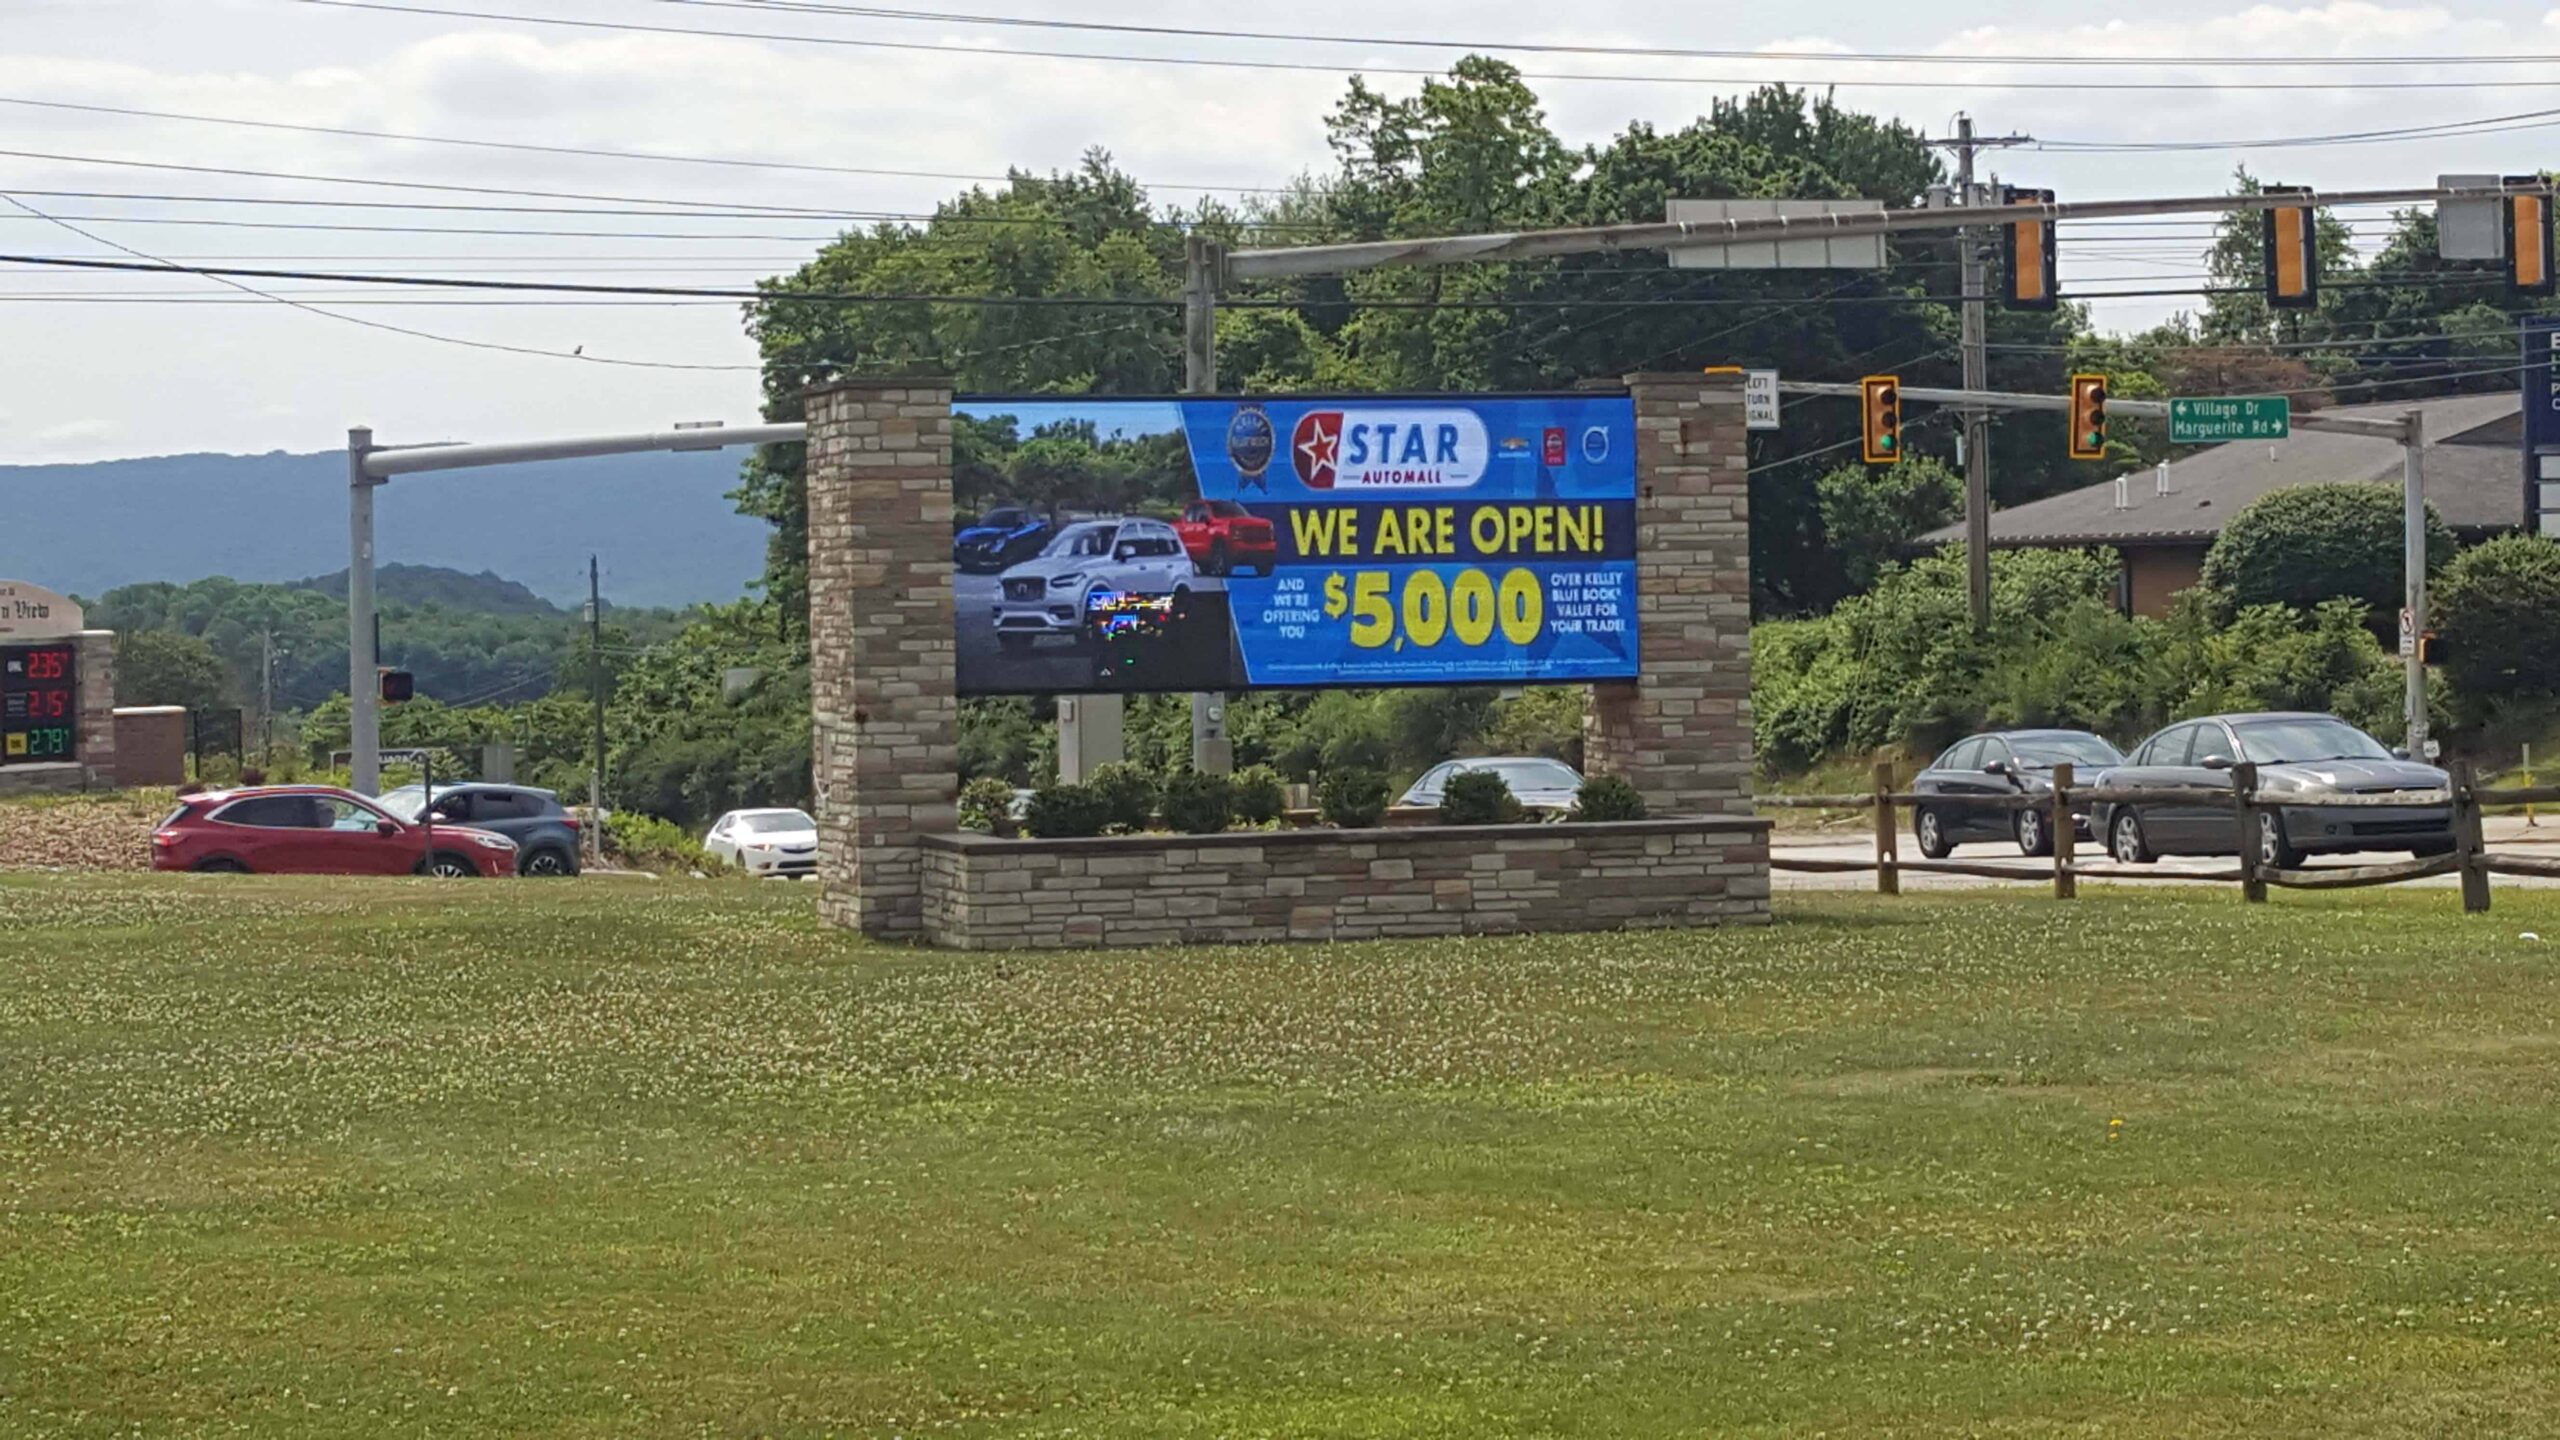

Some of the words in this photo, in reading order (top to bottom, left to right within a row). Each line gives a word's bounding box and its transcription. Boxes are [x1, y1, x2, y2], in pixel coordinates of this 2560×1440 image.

[1747, 393, 1771, 406] TURN
[2192, 402, 2238, 419] Village
[2245, 401, 2260, 415] Dr
[2175, 420, 2244, 438] Marguerite
[2252, 419, 2268, 434] Rd
[1348, 423, 1459, 465] STAR
[1361, 470, 1441, 487] AUTOMALL
[1290, 507, 1359, 556] WE
[1373, 507, 1456, 555] ARE
[1470, 505, 1605, 554] OPEN!
[1277, 577, 1305, 591] AND
[1551, 573, 1582, 586] OVER
[1585, 571, 1623, 585] KELLEY
[1272, 593, 1309, 607] WE'RE
[1552, 588, 1579, 602] BLUE
[1263, 608, 1320, 624] OFFERING
[1323, 567, 1543, 653] $5,000
[1557, 603, 1592, 617] VALUE
[1595, 602, 1618, 616] FOR
[1278, 624, 1306, 639] YOU
[1551, 619, 1583, 633] YOUR
